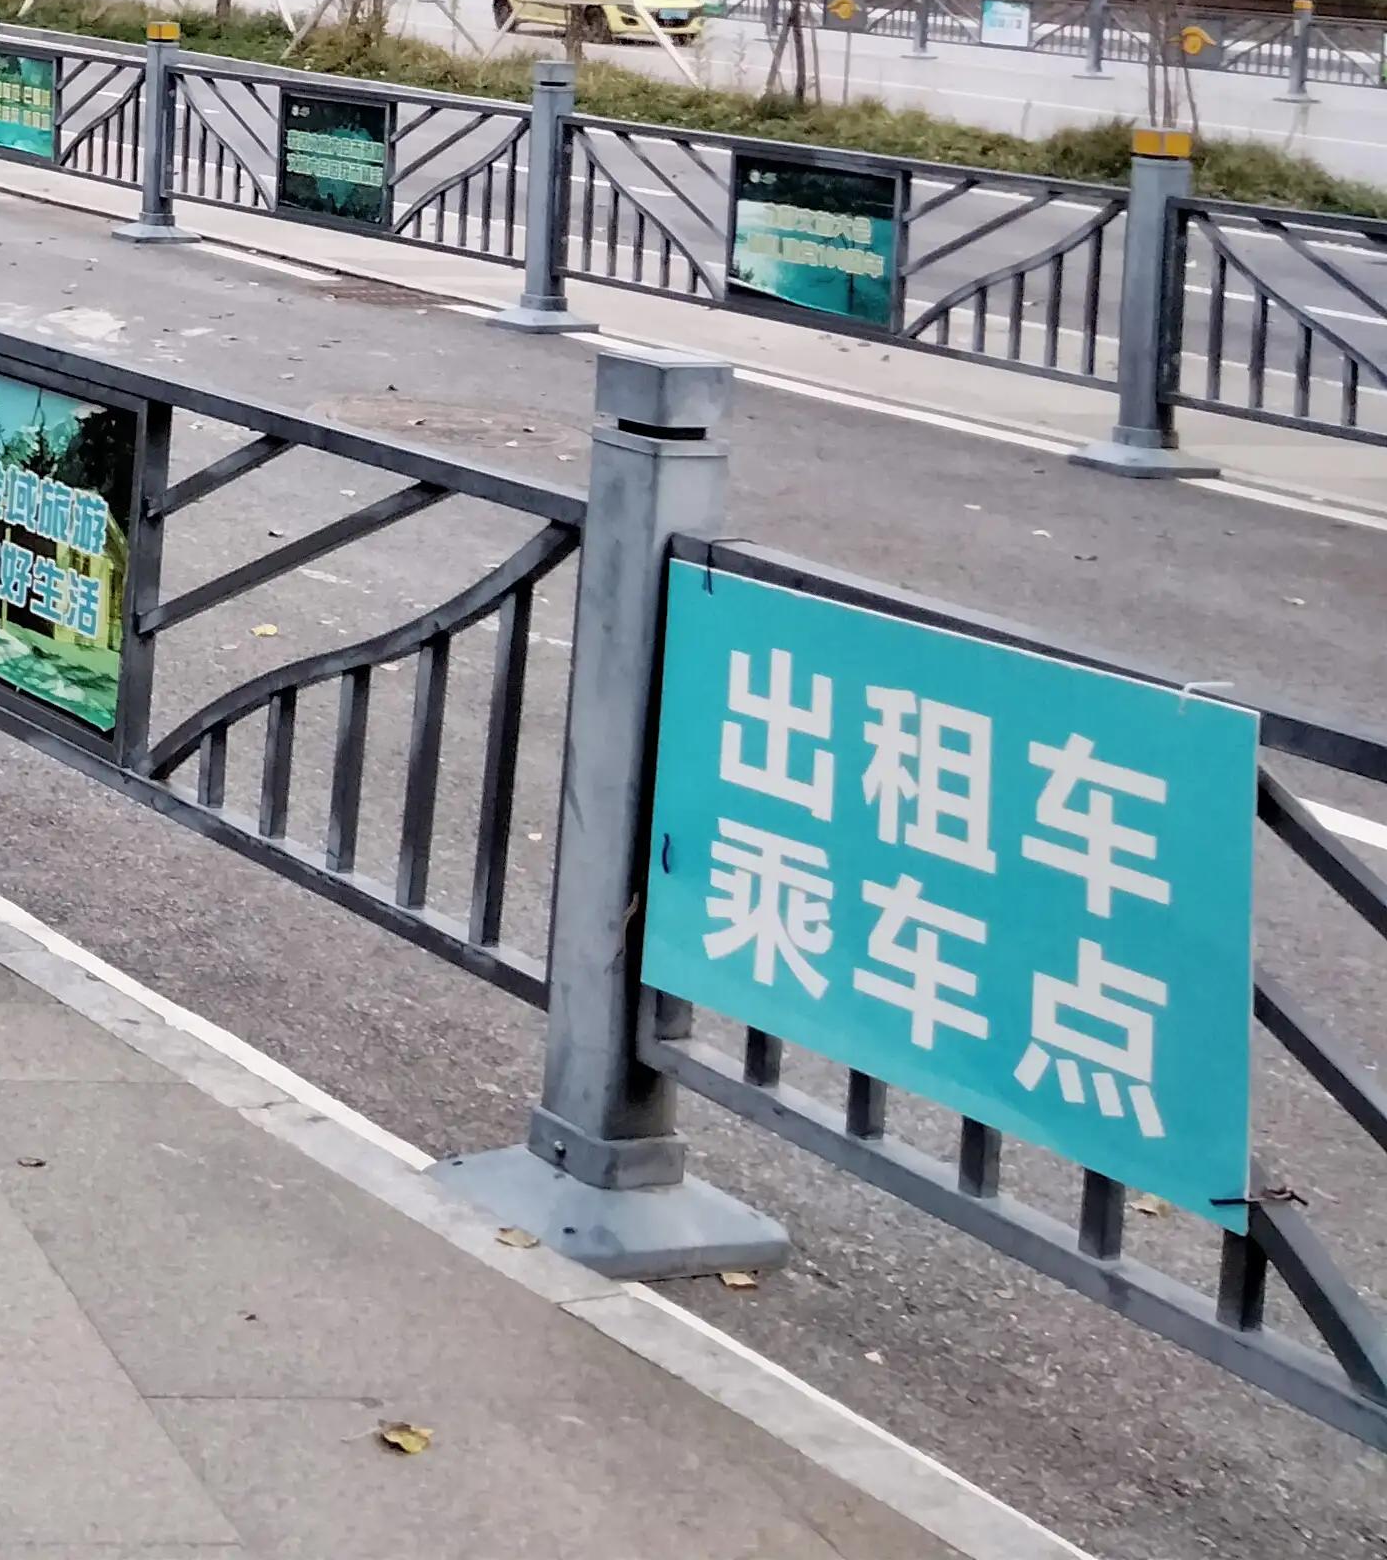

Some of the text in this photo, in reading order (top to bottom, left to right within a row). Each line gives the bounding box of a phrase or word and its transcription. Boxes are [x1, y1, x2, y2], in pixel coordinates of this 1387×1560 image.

[720, 647, 1171, 918] 出租车
[703, 818, 1167, 1138] 乘车点
